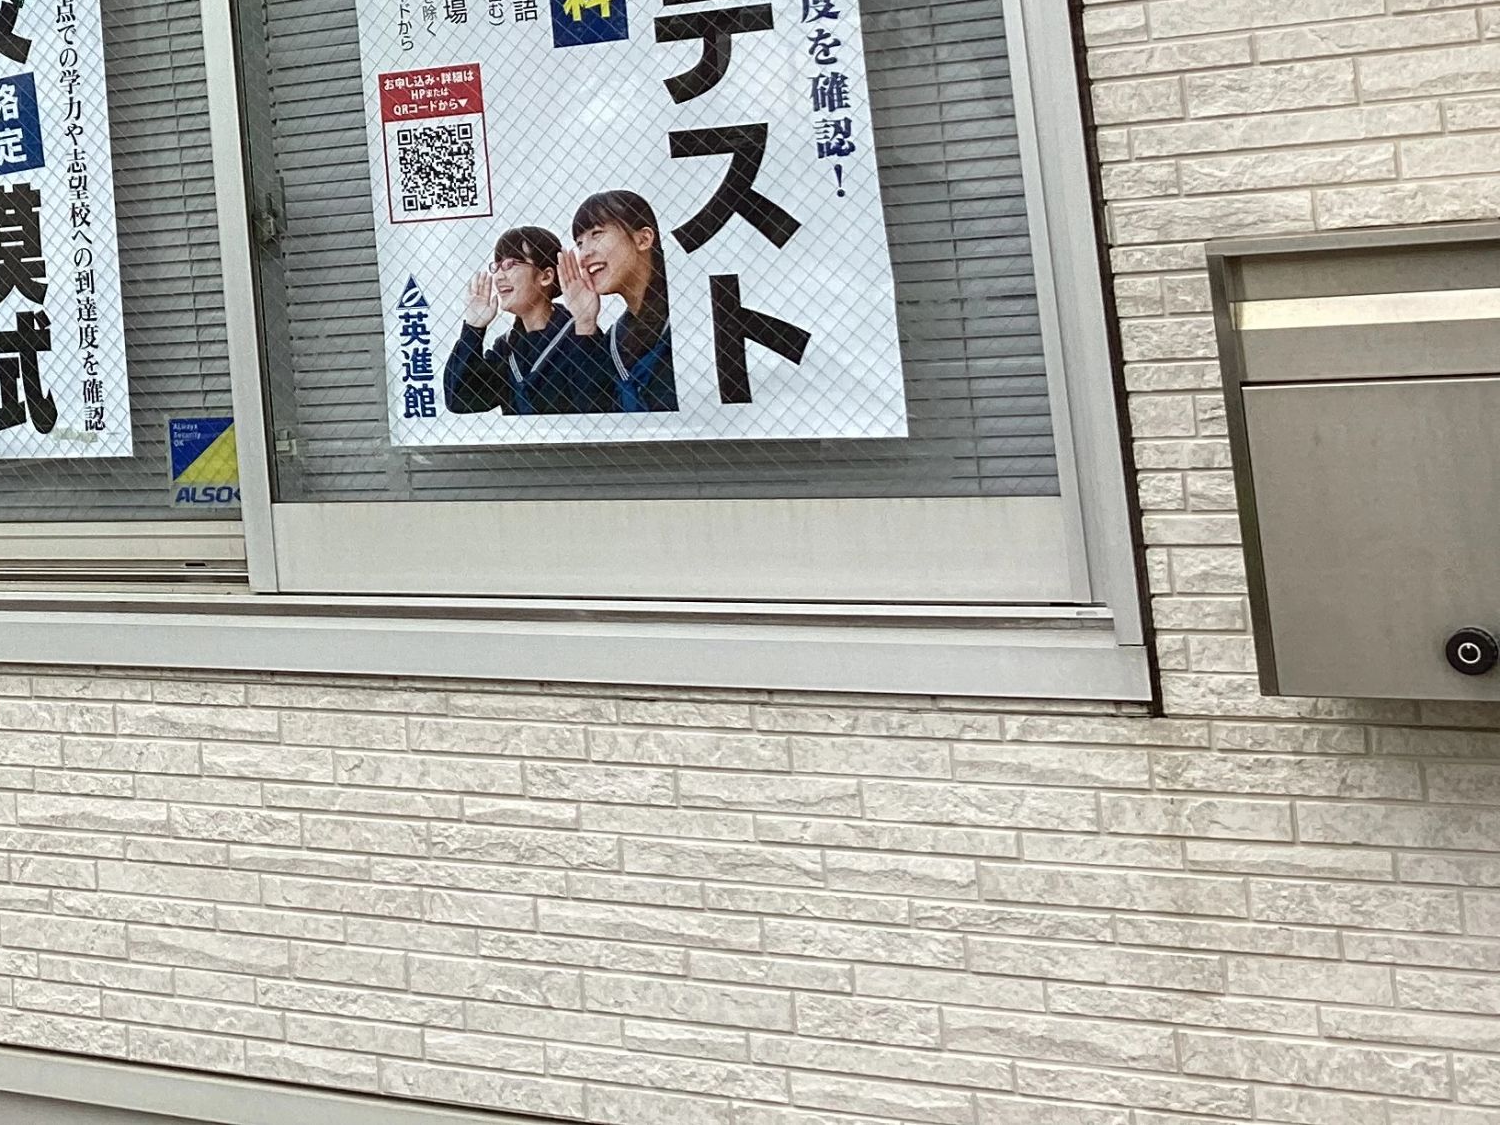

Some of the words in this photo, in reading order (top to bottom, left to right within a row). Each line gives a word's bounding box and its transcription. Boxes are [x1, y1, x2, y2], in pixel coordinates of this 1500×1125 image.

[383, 70, 475, 91] お申し込み・詳細は
[410, 86, 449, 101] HPまたは
[398, 311, 437, 419] 英進館
